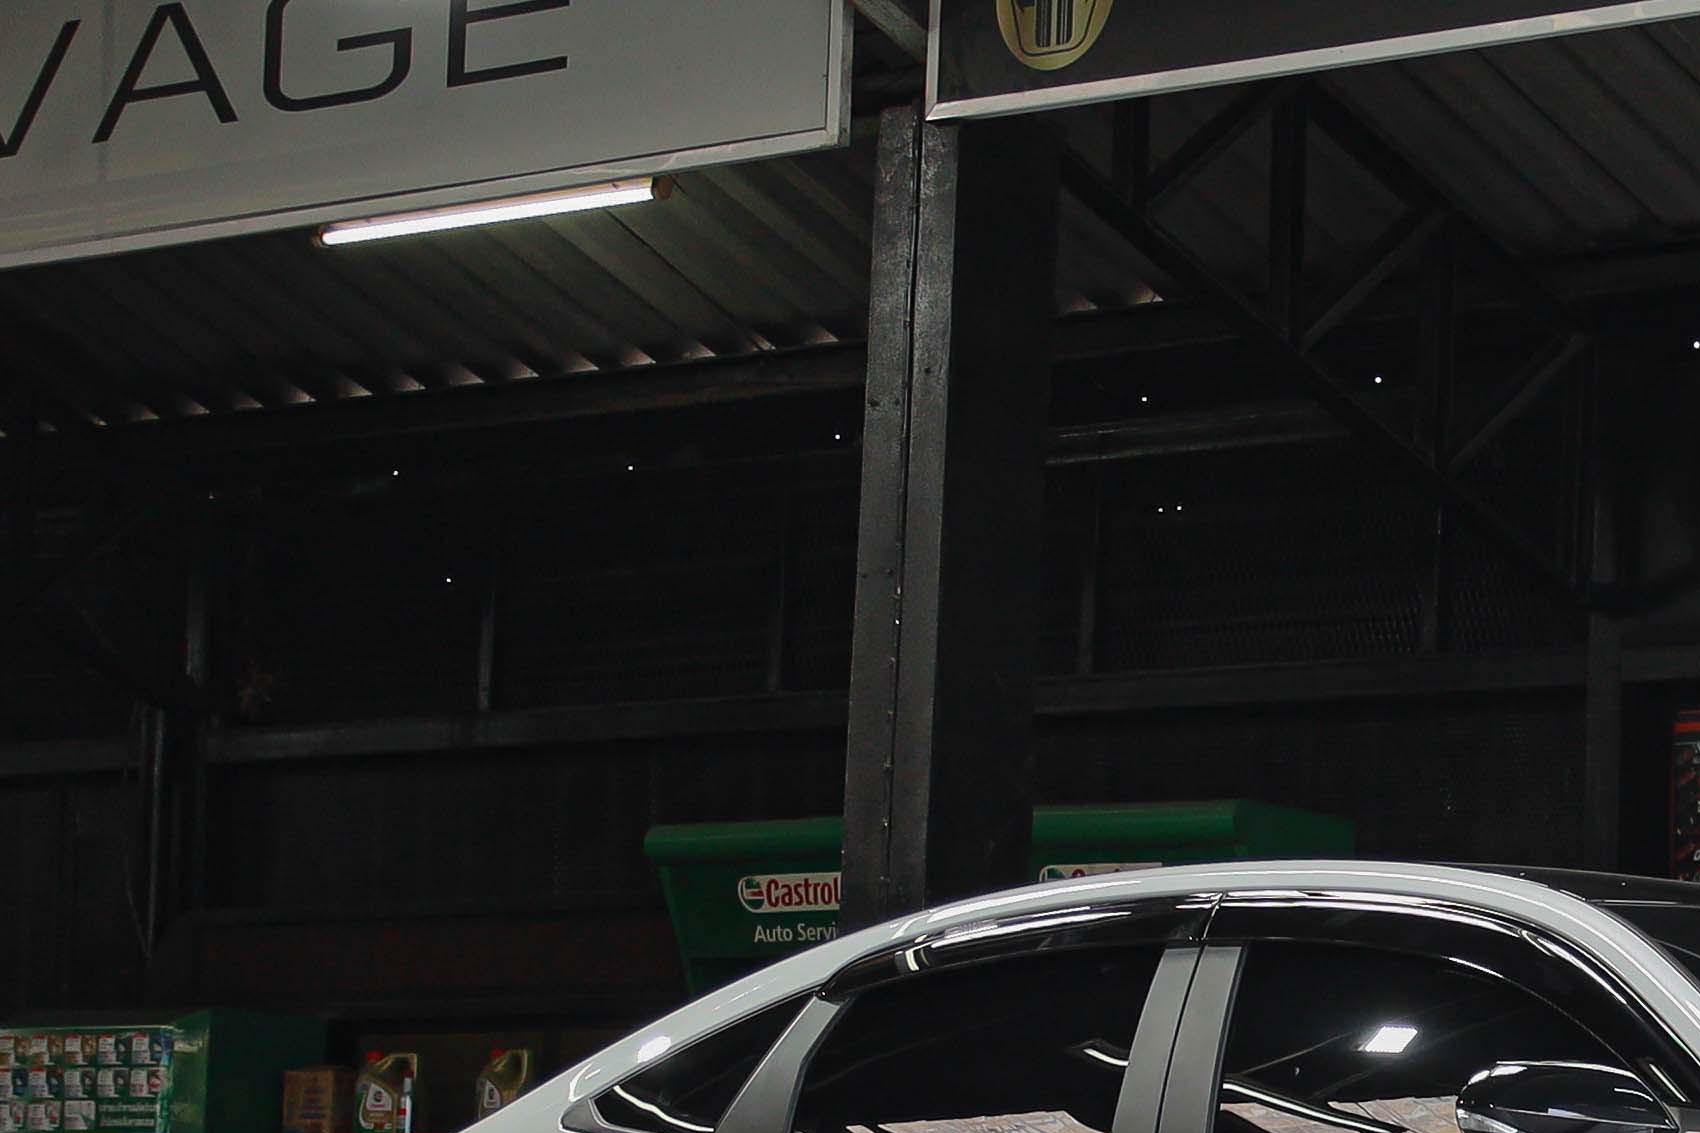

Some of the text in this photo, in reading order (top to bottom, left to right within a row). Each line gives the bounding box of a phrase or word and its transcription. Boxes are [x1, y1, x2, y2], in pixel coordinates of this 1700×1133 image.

[766, 878, 841, 907] Castrol
[754, 921, 837, 943] Auto Servi
